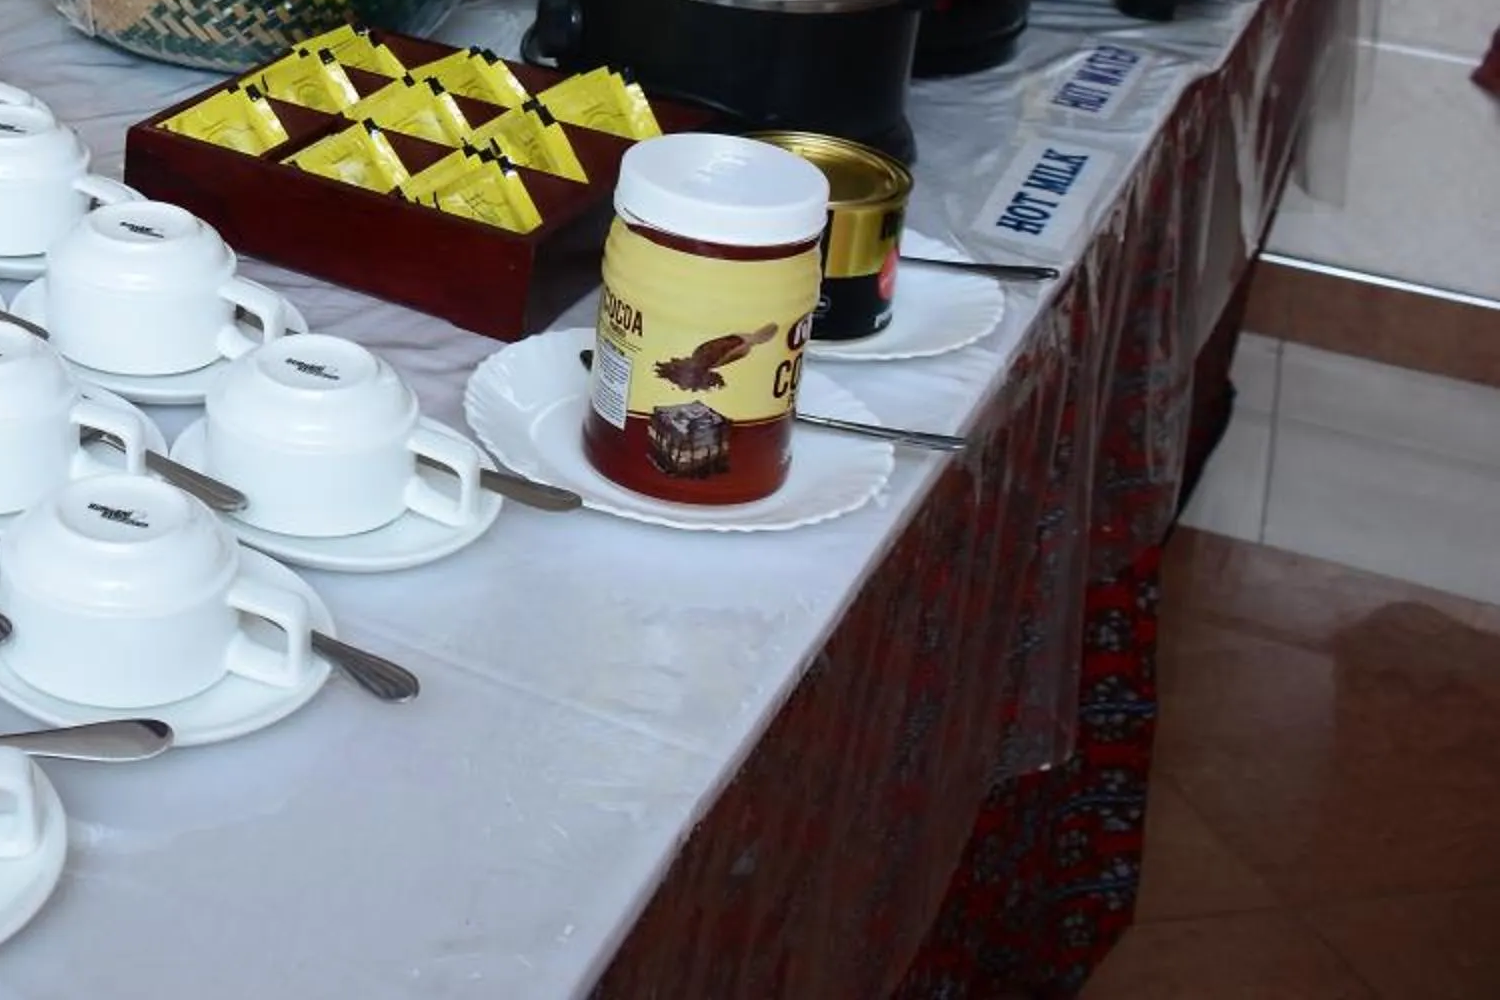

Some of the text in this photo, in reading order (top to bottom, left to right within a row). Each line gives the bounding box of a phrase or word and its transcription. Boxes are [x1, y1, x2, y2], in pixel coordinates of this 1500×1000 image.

[996, 149, 1089, 236] HOT MILK
[603, 286, 643, 337] COCOA
